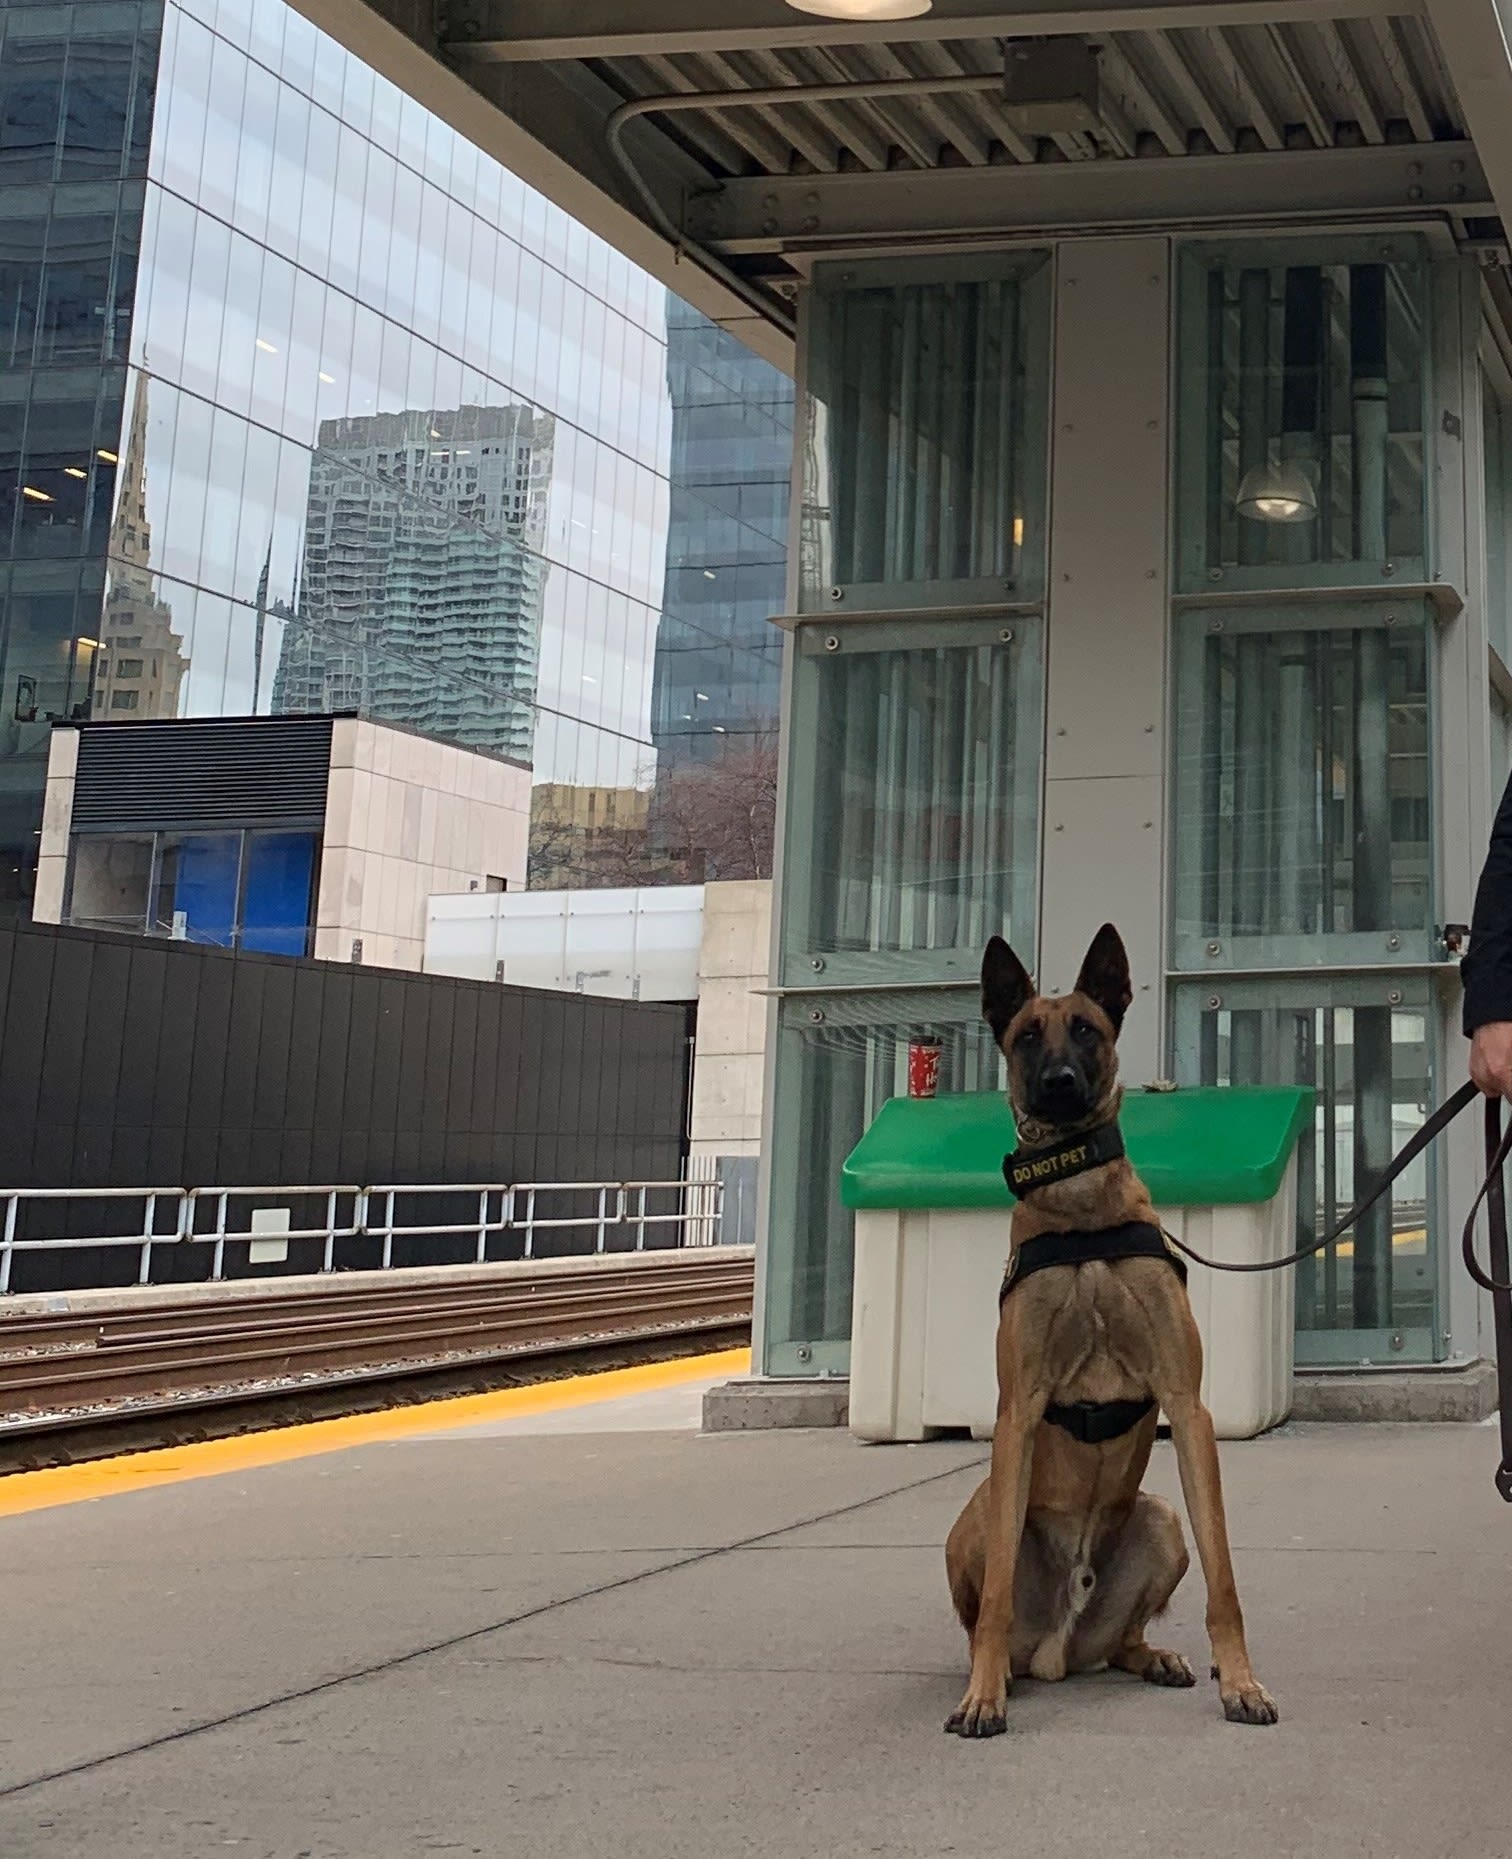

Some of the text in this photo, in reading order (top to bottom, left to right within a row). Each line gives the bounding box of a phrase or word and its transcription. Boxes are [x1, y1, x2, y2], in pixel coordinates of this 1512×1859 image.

[1013, 1145, 1087, 1183] DO NOT PET
